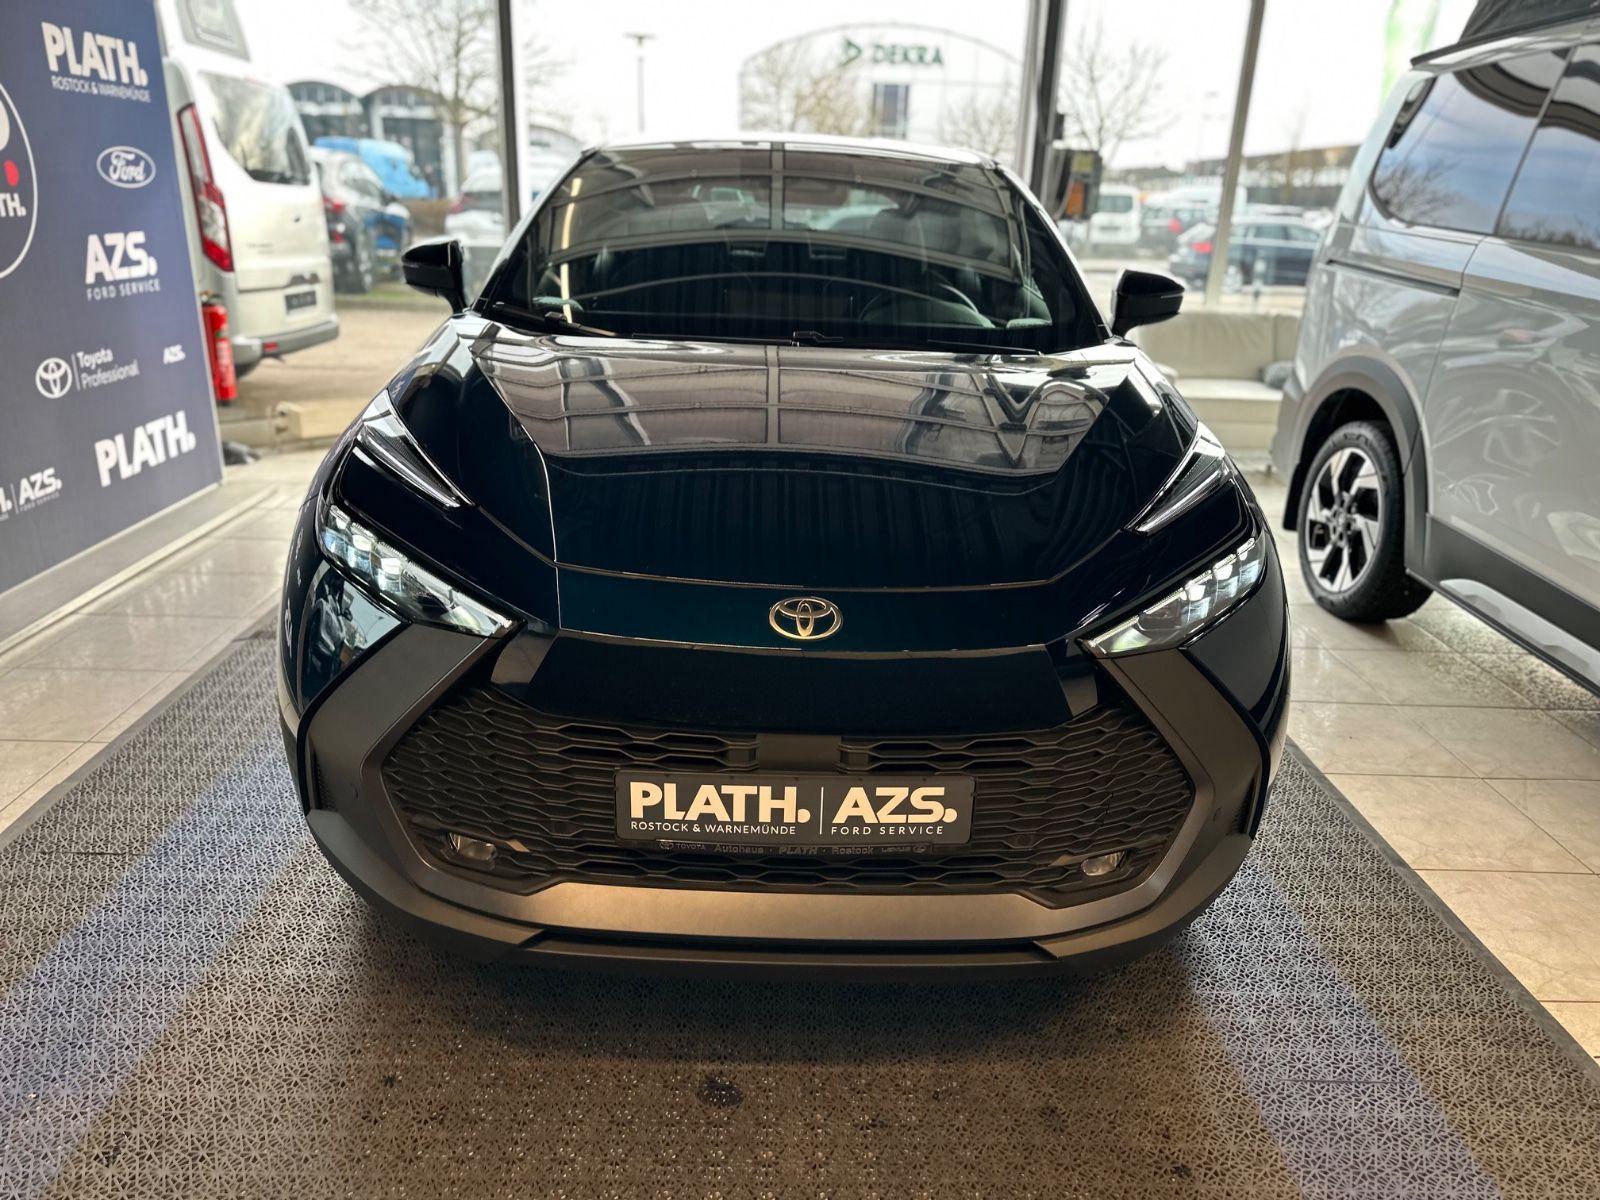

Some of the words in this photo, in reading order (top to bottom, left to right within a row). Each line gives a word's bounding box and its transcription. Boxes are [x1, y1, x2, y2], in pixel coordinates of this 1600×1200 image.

[41, 22, 148, 86] PLATH.
[872, 43, 943, 64] DEKRA
[109, 151, 146, 182] Ford
[86, 285, 117, 301] FORD
[119, 278, 161, 297] SERVICE
[77, 348, 114, 369] Toyota
[81, 360, 140, 389] Professional
[95, 410, 196, 487] PLATH.
[629, 781, 811, 824] PLATH.
[832, 786, 958, 824] AZS.
[631, 821, 689, 832] ROSTOCK
[692, 823, 701, 833] &
[704, 822, 796, 836] WARNEMÜNDE
[831, 826, 872, 836] FORD
[879, 826, 944, 836] SERVICE
[676, 843, 706, 851] TOYOTA
[714, 844, 765, 855] Autohaus
[831, 846, 874, 856] Rostock
